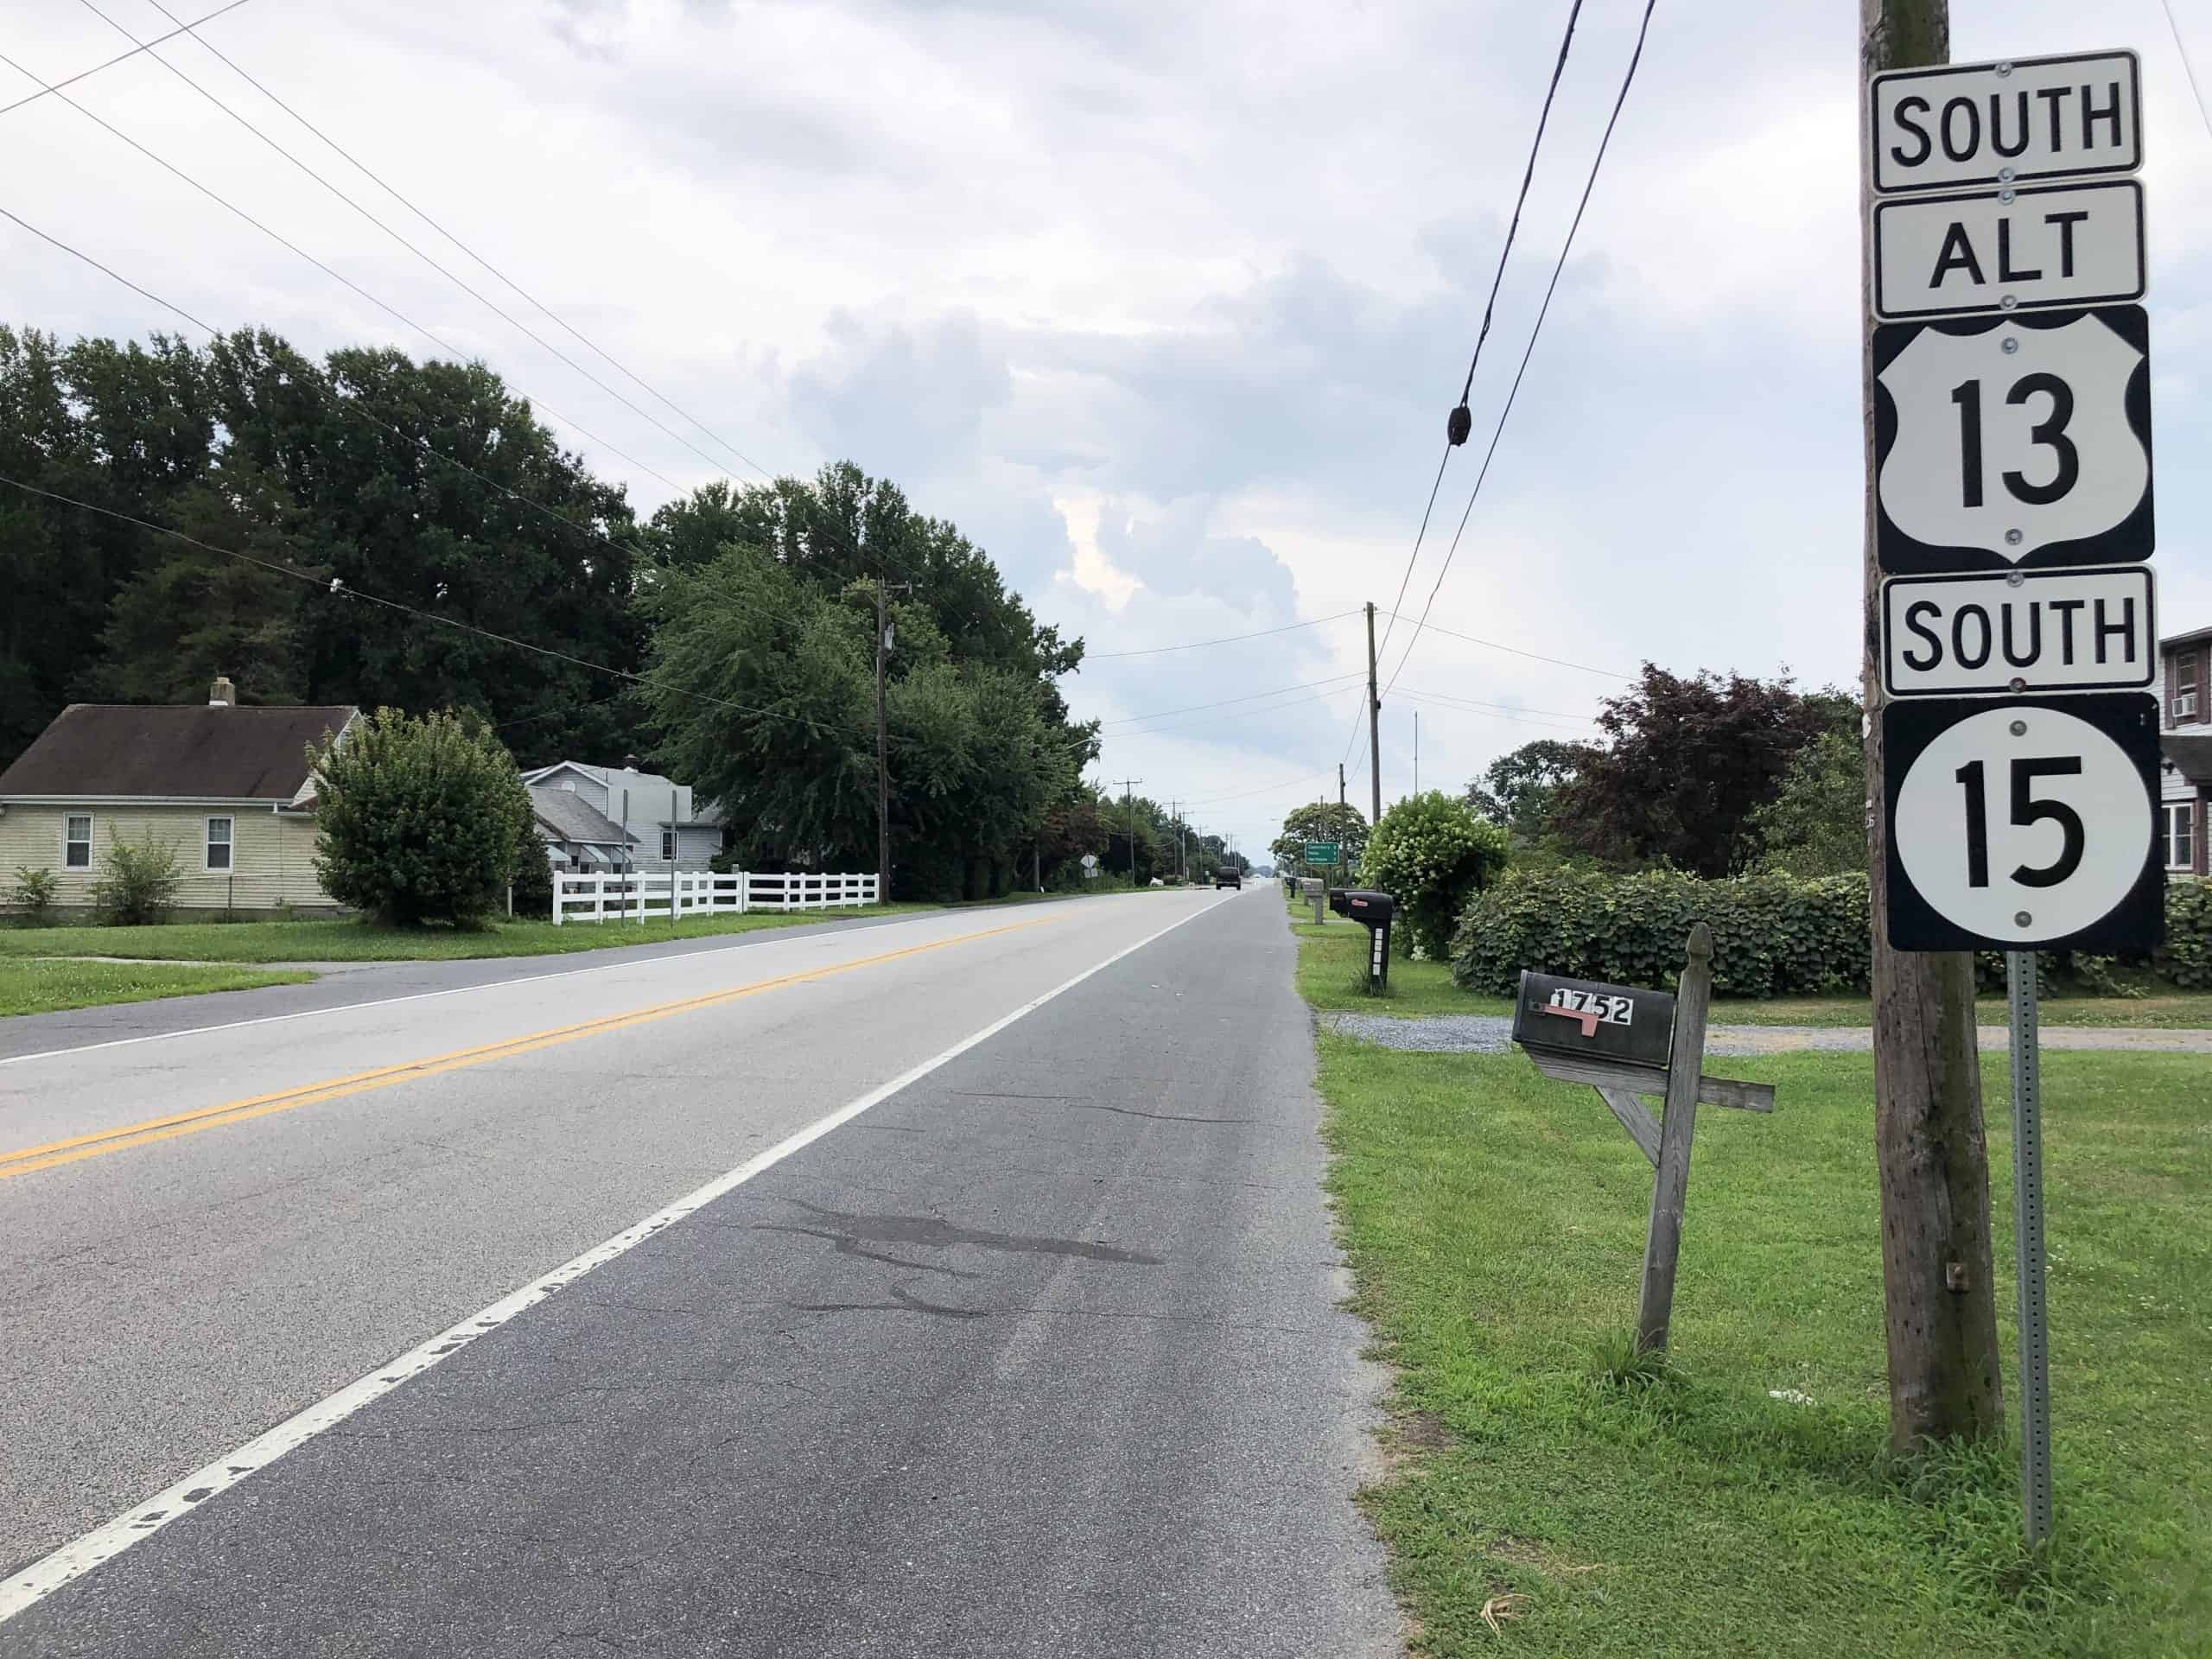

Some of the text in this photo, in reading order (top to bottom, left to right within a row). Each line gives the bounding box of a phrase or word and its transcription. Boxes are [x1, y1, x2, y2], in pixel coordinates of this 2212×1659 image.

[1891, 82, 2122, 168] SOUTH
[1929, 210, 2088, 289] ALT
[1951, 372, 2080, 508] 13
[1902, 597, 2137, 672] SOUTH
[1955, 755, 2085, 888] 15
